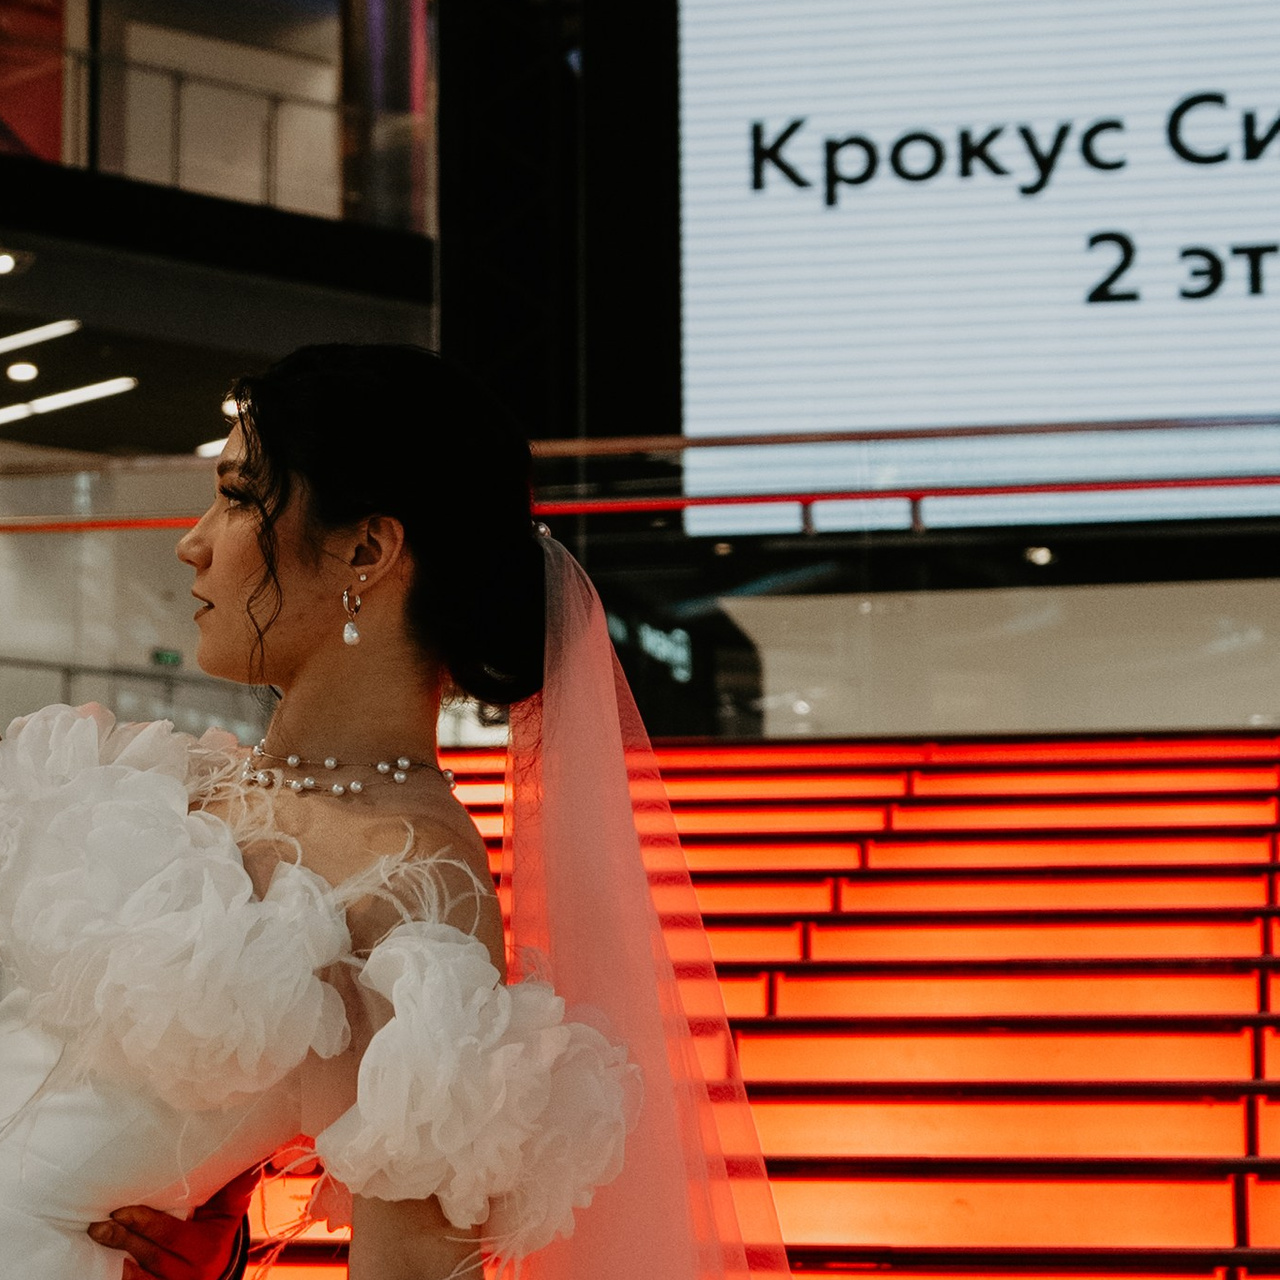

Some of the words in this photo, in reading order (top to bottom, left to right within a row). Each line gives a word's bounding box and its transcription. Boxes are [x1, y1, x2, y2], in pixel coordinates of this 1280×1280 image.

[749, 117, 1128, 208] Крокус
[1085, 231, 1141, 305] 2
[1178, 243, 1280, 301] эт
